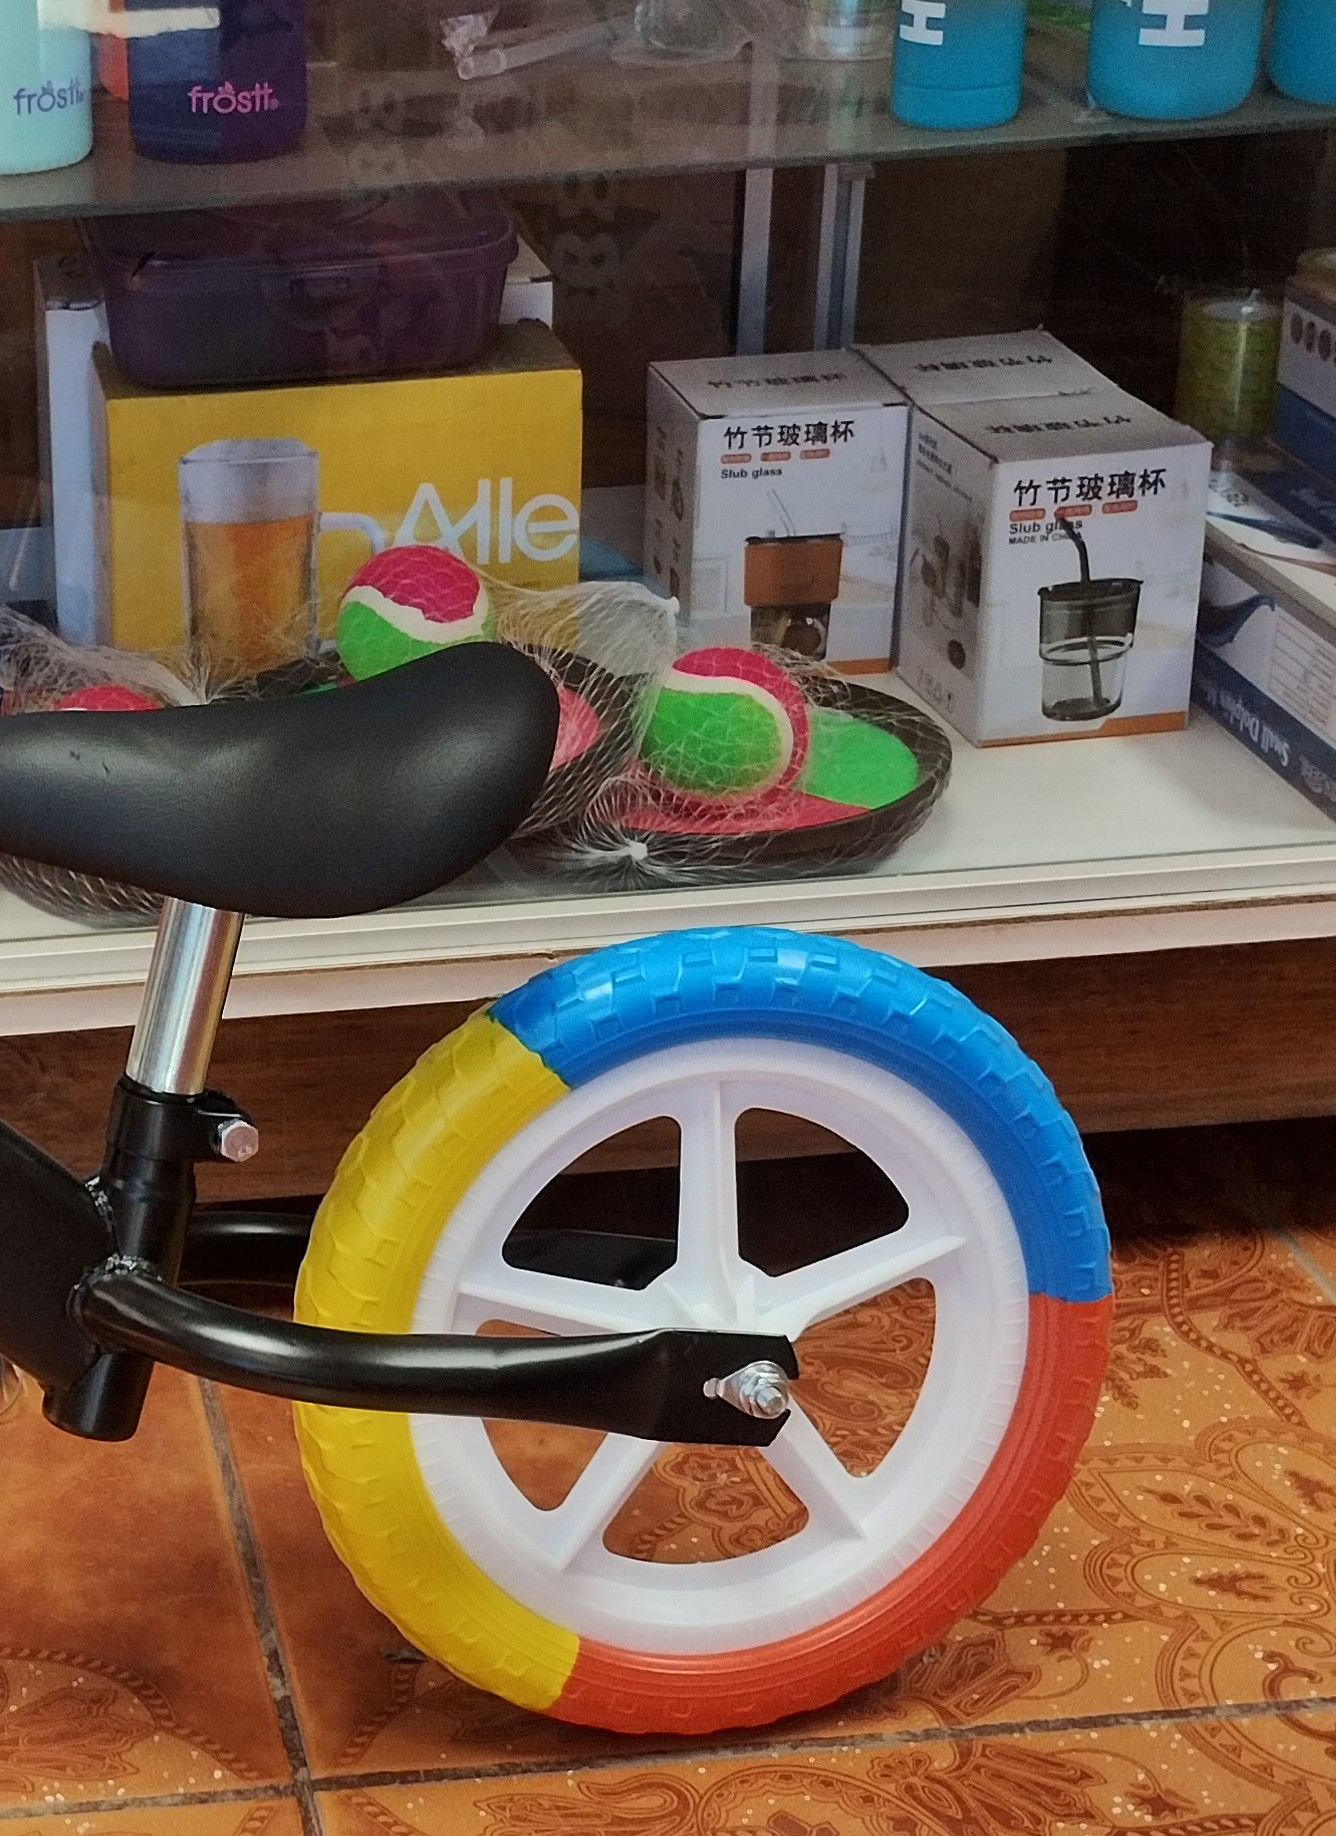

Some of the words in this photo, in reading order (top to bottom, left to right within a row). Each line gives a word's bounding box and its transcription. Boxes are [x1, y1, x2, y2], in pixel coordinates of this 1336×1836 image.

[723, 419, 855, 450] 竹节玻璃杯
[720, 468, 748, 479] Slub
[752, 466, 783, 479] glass
[1014, 468, 1167, 507] 竹节玻璃杯
[1009, 522, 1041, 535] Slub
[1009, 535, 1037, 545] MADE
[1039, 533, 1050, 543] IN
